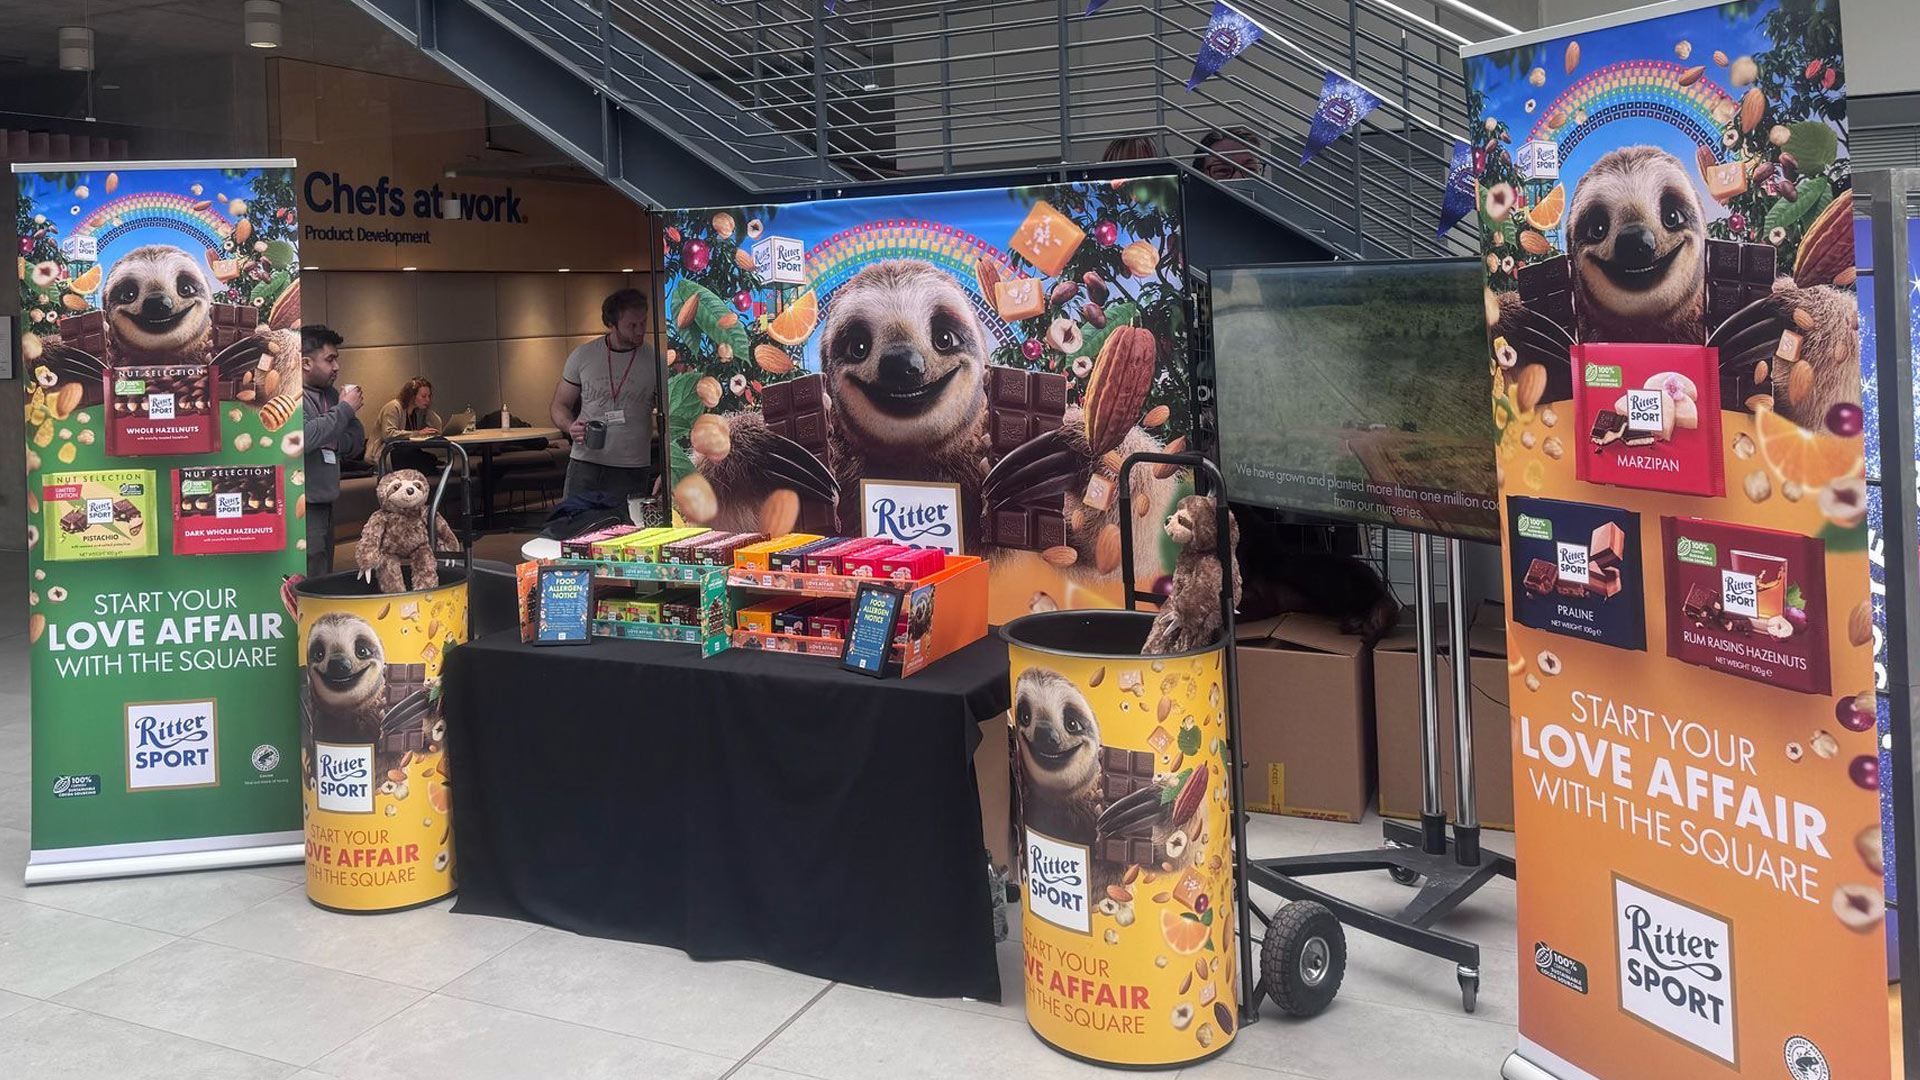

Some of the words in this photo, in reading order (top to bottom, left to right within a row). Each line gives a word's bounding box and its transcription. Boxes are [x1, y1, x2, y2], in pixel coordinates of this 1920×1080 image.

[303, 170, 406, 217] Chefs
[413, 183, 444, 219] at
[305, 225, 354, 242] Product
[357, 228, 431, 246] Development
[776, 245, 800, 262] Ritter
[777, 262, 801, 272] SPORT
[145, 368, 204, 377] SELECTION
[1630, 395, 1658, 412] Ritter
[1631, 412, 1660, 422] SPORT
[212, 468, 270, 477] SELECTION
[1617, 455, 1680, 472] MARZIPAN
[56, 476, 77, 484] NUT
[84, 474, 142, 482] SELECTION
[1236, 464, 1252, 476] We
[1254, 464, 1274, 480] have
[1276, 472, 1306, 484] grown
[1307, 474, 1326, 487] and
[1328, 475, 1364, 492] planted
[1366, 483, 1392, 496] more
[1394, 484, 1418, 500] than
[1420, 491, 1441, 502] one
[1444, 490, 1480, 508] million
[89, 502, 110, 512] Ritter
[1334, 492, 1355, 508] from
[1358, 500, 1374, 511] our
[1376, 503, 1424, 520] nurseries.
[872, 498, 952, 541] Ritter
[1560, 548, 1586, 564] Ritter
[1692, 541, 1710, 551] 100%
[1560, 563, 1586, 576] SPORT
[1725, 576, 1754, 595] Ritter
[94, 592, 163, 615] START
[168, 588, 237, 612] YOUR
[863, 606, 890, 616] ALLERGEN
[870, 598, 886, 608] FOOD
[1726, 593, 1755, 608] SPORT
[864, 614, 884, 624] NOTICE
[1557, 604, 1594, 622] PRALINE
[48, 619, 144, 651] LOVE
[156, 612, 285, 645] AFFAIR
[1551, 620, 1561, 628] NET
[1562, 622, 1582, 632] WEIGHT
[1684, 630, 1707, 647] RUM
[1708, 636, 1745, 656] RAISINS
[1746, 646, 1808, 670] HAZELNUTS
[55, 654, 122, 678] WITH
[128, 652, 174, 674] THE
[179, 646, 278, 672] SQUARE
[1716, 655, 1726, 664] NET
[1727, 658, 1750, 670] WEIGHT
[134, 714, 208, 749] Ritter
[1571, 691, 1656, 744] START
[1661, 714, 1758, 776] YOUR
[135, 748, 209, 770] SPORT
[320, 754, 368, 782] Ritter
[320, 781, 368, 798] SPORT
[1520, 716, 1632, 790] LOVE
[1646, 756, 1832, 859] AFFAIR
[311, 824, 340, 843] START
[344, 829, 389, 846] YOUR
[1528, 768, 1607, 824] WITH
[1614, 796, 1672, 848] THE
[1680, 820, 1820, 905] SQUARE
[305, 838, 332, 865] OVE
[337, 844, 420, 868] AFFAIR
[1030, 844, 1082, 886] Ritter
[324, 869, 346, 886] THE
[350, 866, 416, 887] SQUARE
[1032, 878, 1082, 912] SPORT
[1024, 927, 1052, 961] START
[1056, 947, 1110, 978] YOUR
[1624, 904, 1722, 982] Ritter
[1554, 952, 1578, 972] 100%
[1551, 967, 1582, 986] SUSTAINABLE
[1049, 970, 1150, 1010] AFFAIR
[1627, 958, 1724, 1026] SPORT
[1036, 988, 1061, 1018] THE
[1064, 1004, 1145, 1034] SQUARE
